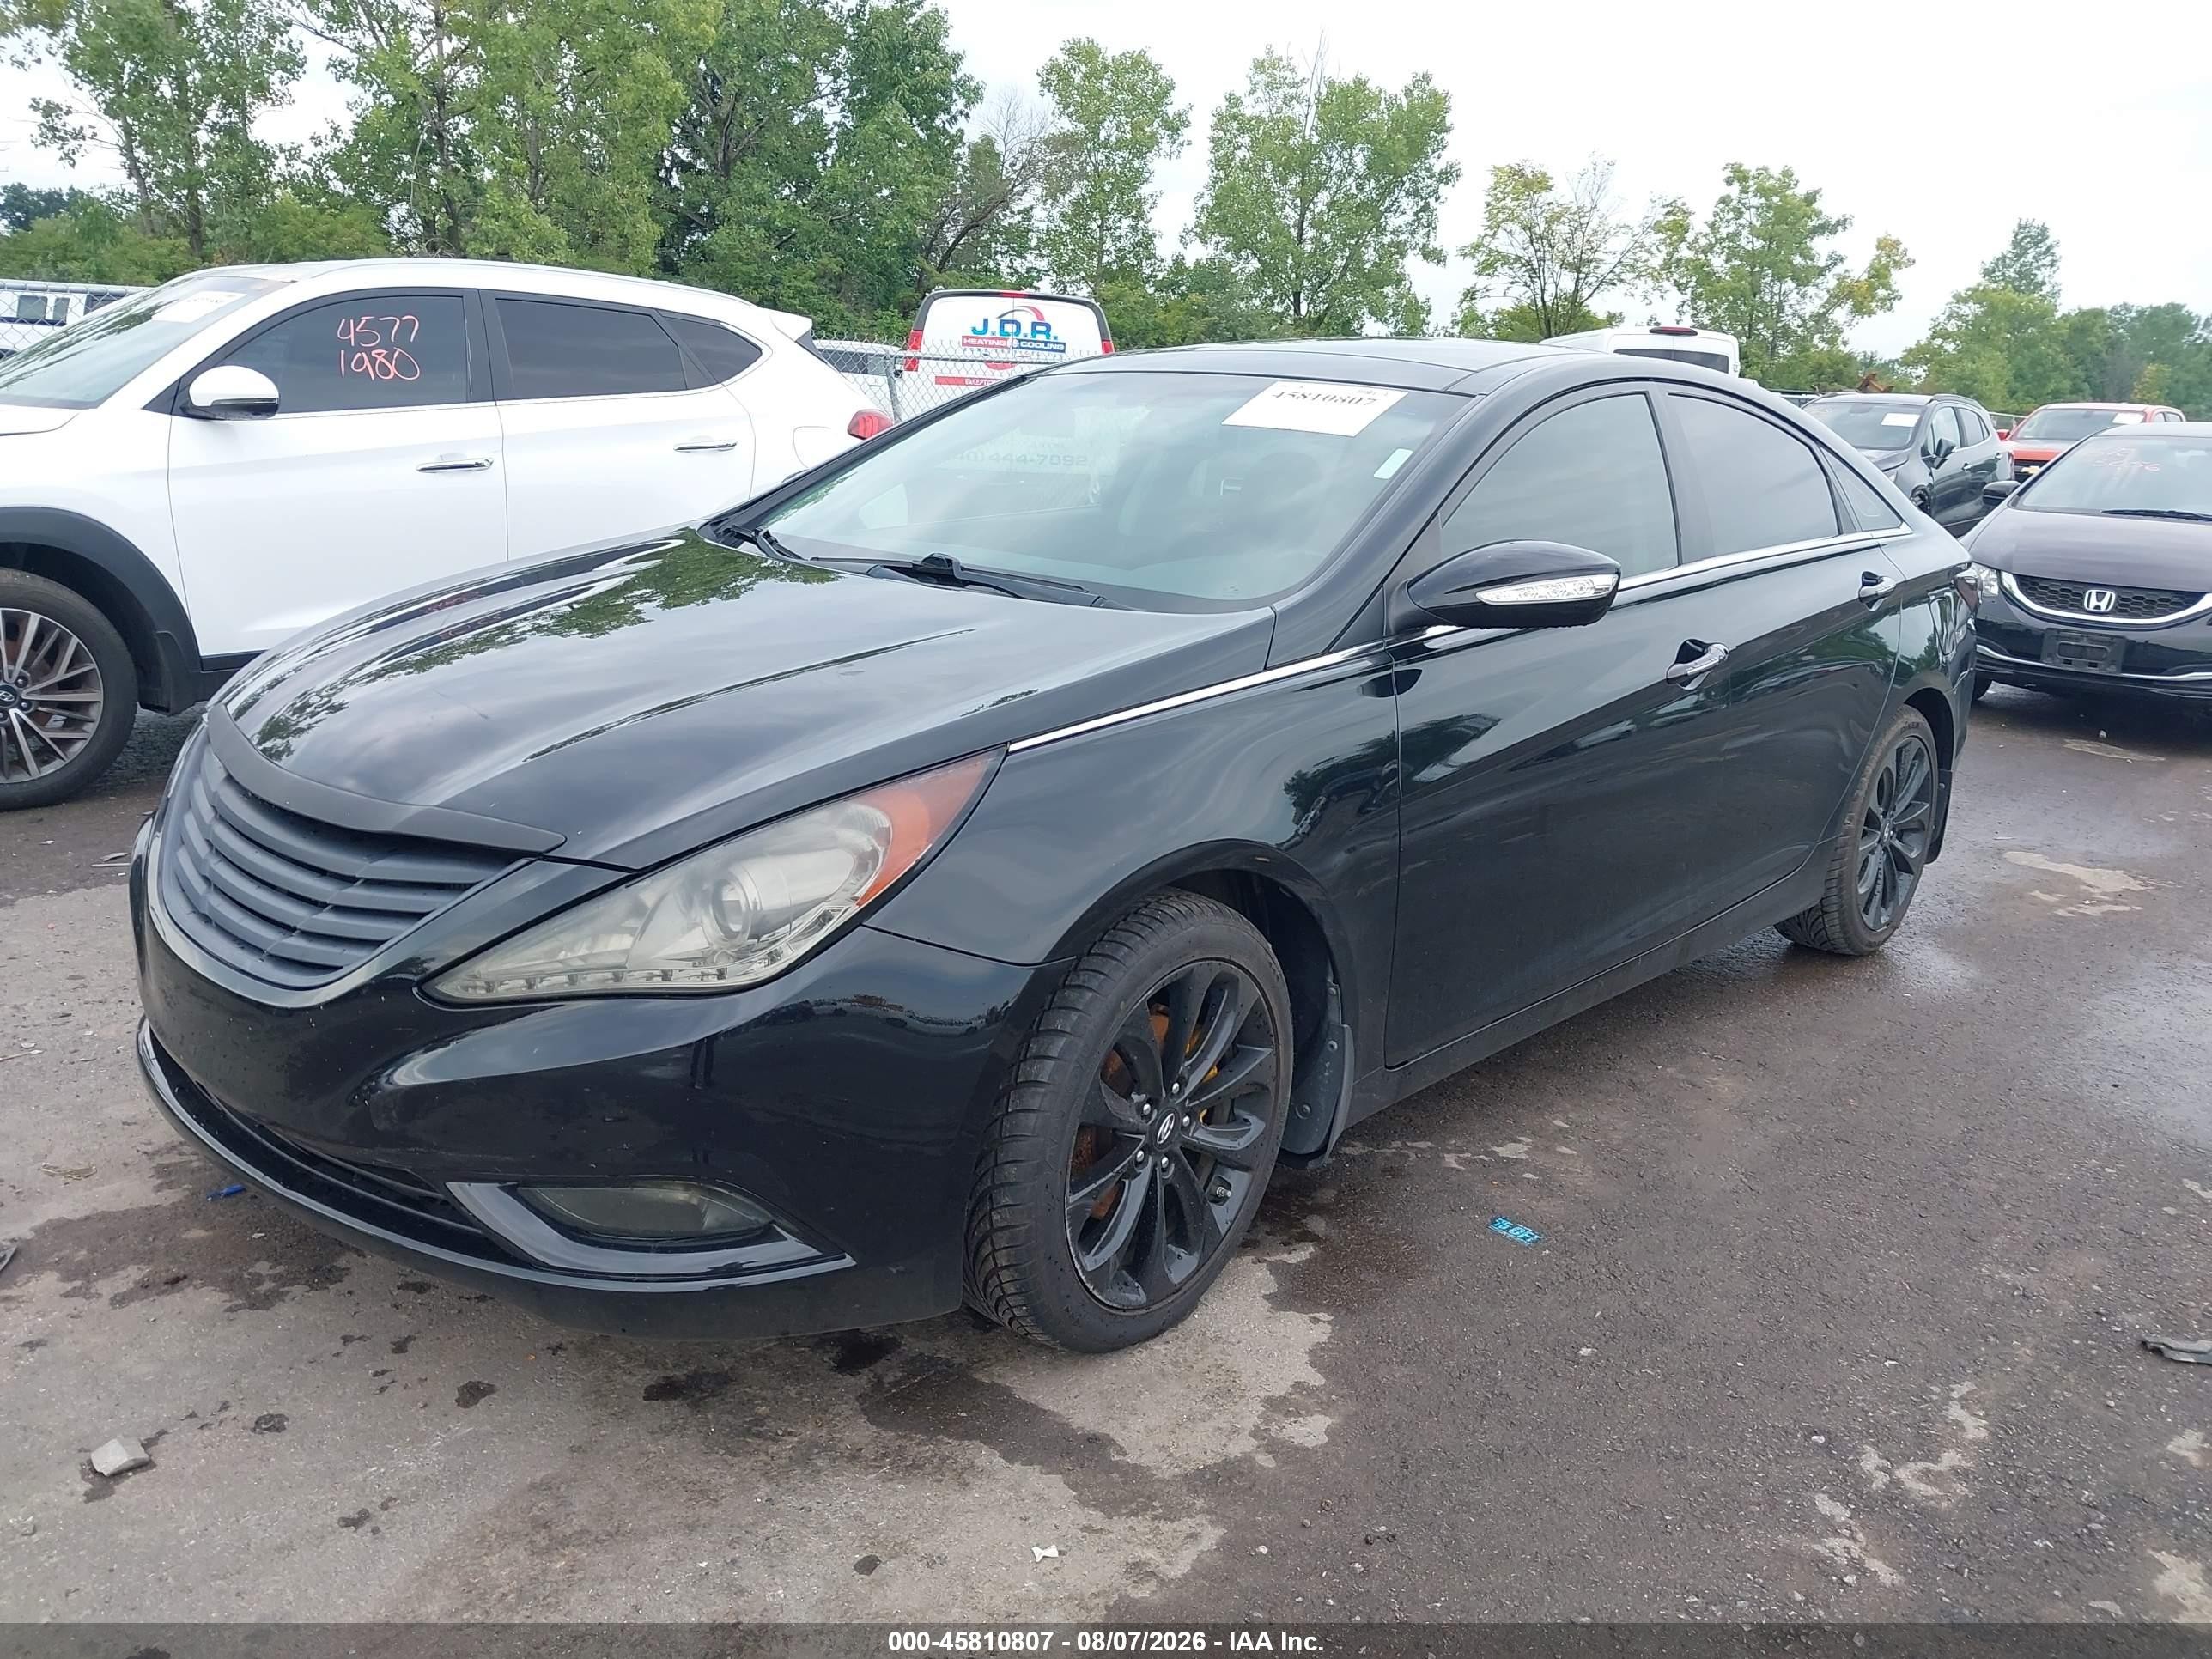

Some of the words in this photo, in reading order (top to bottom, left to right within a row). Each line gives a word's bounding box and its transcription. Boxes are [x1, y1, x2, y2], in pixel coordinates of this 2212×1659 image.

[337, 315, 419, 347] 4577
[971, 318, 1058, 340] J.D.R.
[963, 337, 1006, 347] HEATING
[1020, 341, 1065, 350] COOLING
[340, 347, 420, 380] 1980
[1272, 390, 1377, 406] 45810807
